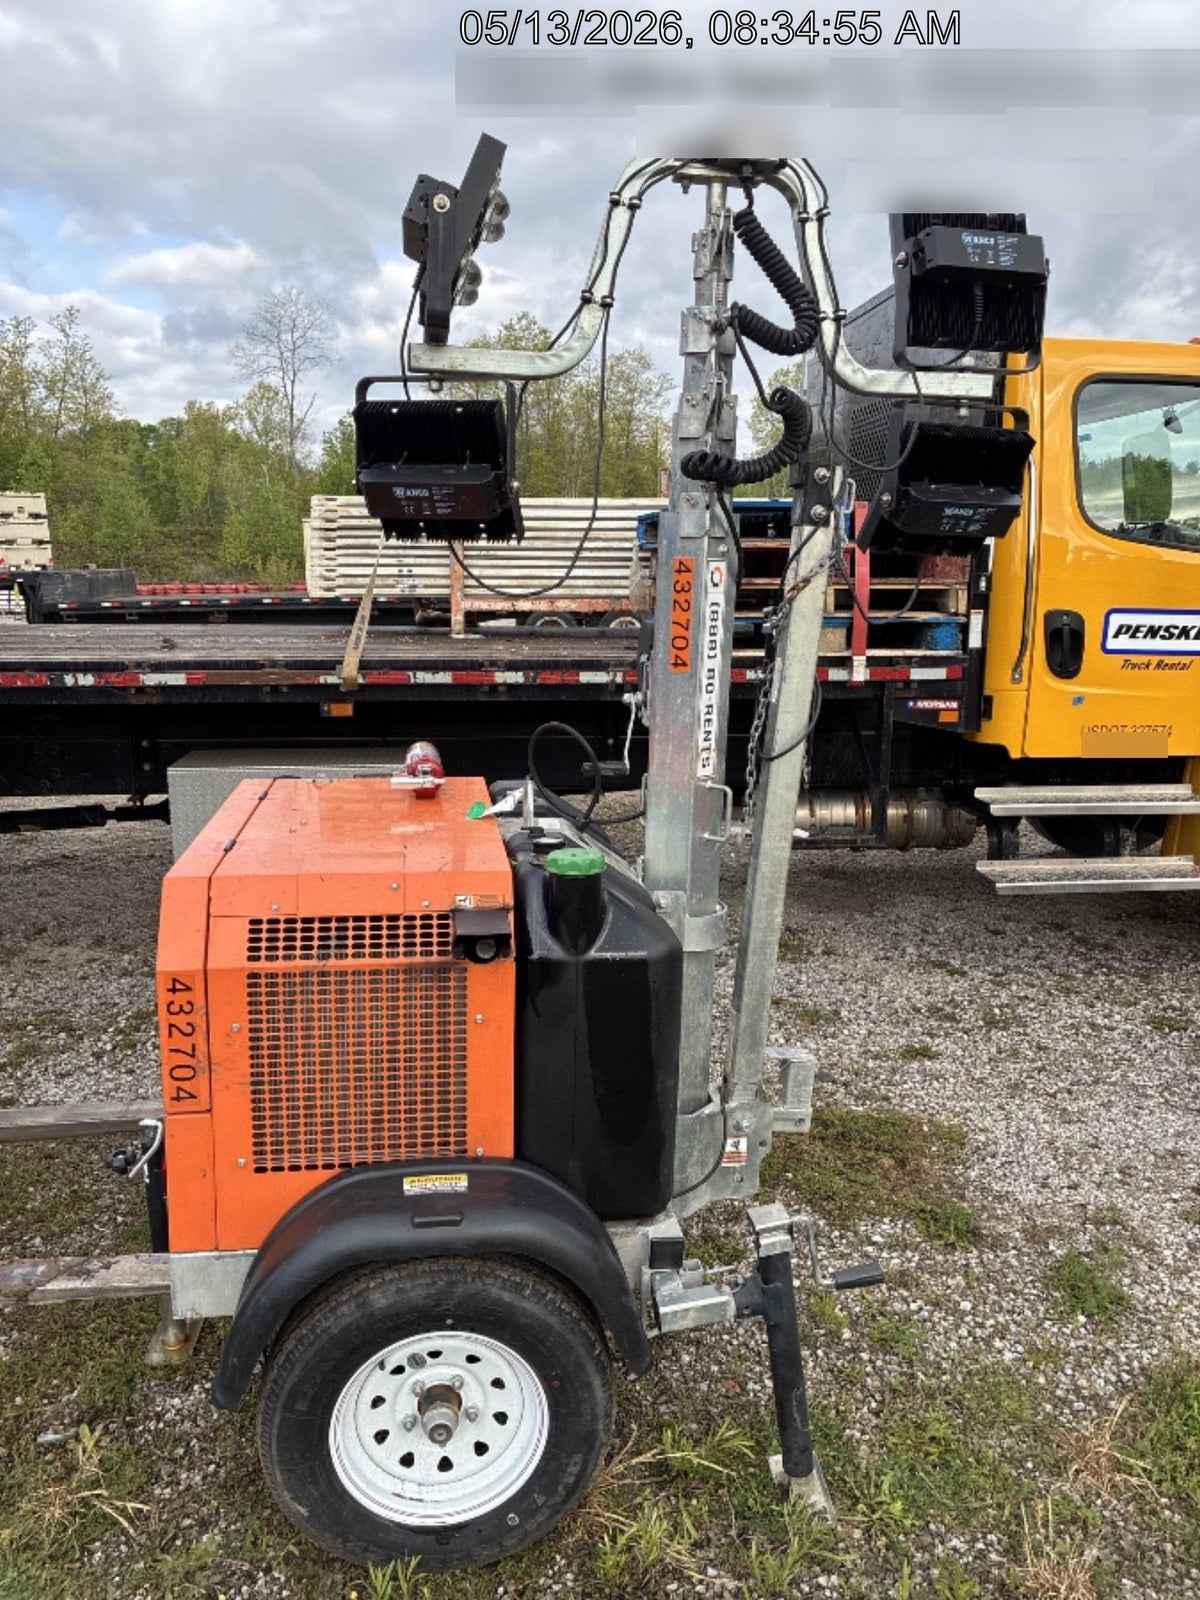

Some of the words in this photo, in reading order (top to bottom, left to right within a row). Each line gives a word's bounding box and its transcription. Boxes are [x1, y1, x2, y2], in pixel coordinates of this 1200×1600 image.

[671, 560, 692, 669] 432704
[1121, 659, 1151, 671] Truck
[1154, 660, 1193, 671] Rental
[166, 977, 197, 1102] 432704
